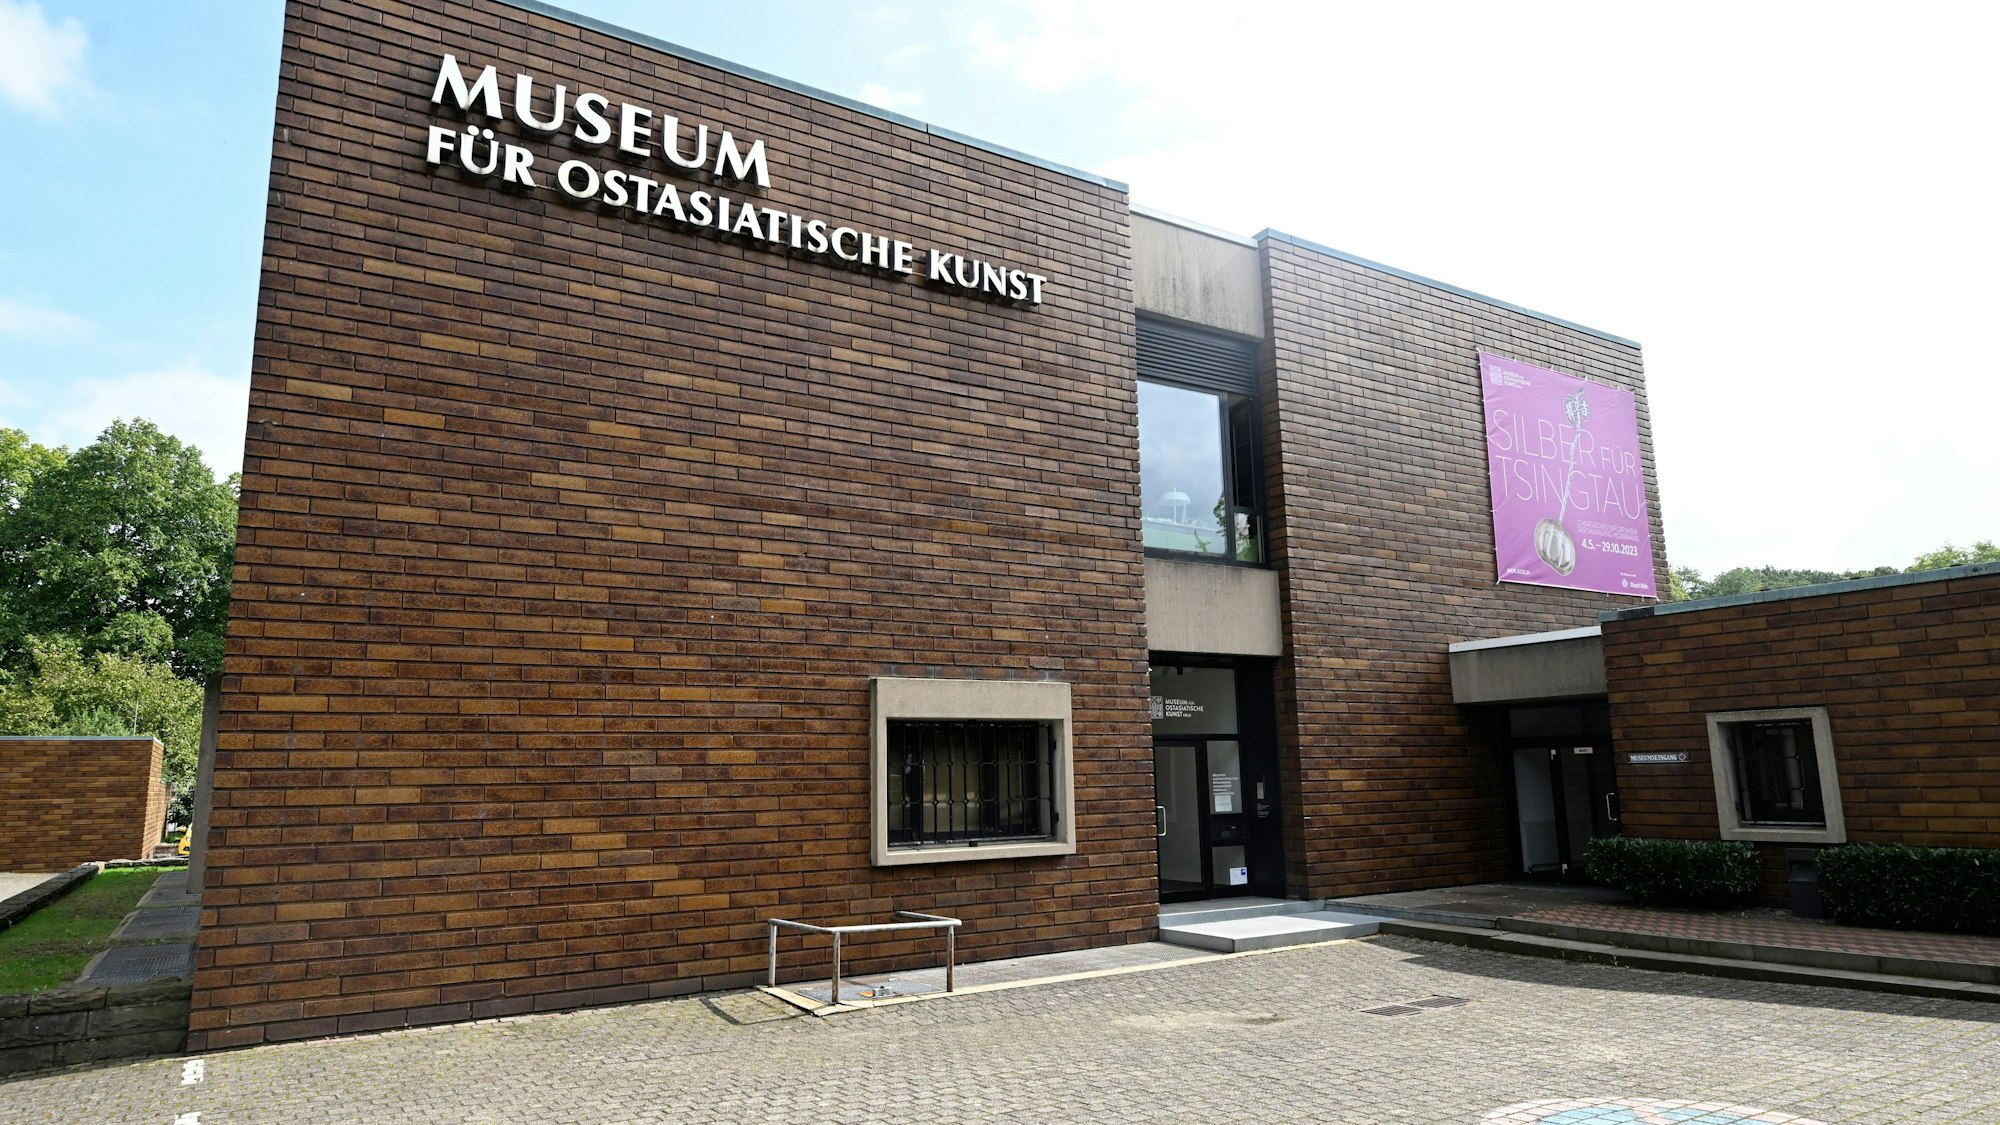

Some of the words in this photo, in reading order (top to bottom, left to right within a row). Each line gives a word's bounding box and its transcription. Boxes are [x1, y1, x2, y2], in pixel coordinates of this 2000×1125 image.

[431, 53, 772, 190] MUSEUM
[426, 124, 536, 189] FÜR
[556, 159, 914, 275] OSTASIATISCHE
[928, 248, 1048, 305] KUNST
[1493, 409, 1596, 469] SILBER
[1601, 445, 1637, 477] FÜR
[1495, 454, 1641, 519] TSINGTAU
[1165, 704, 1204, 712] OSTASIATISCHE
